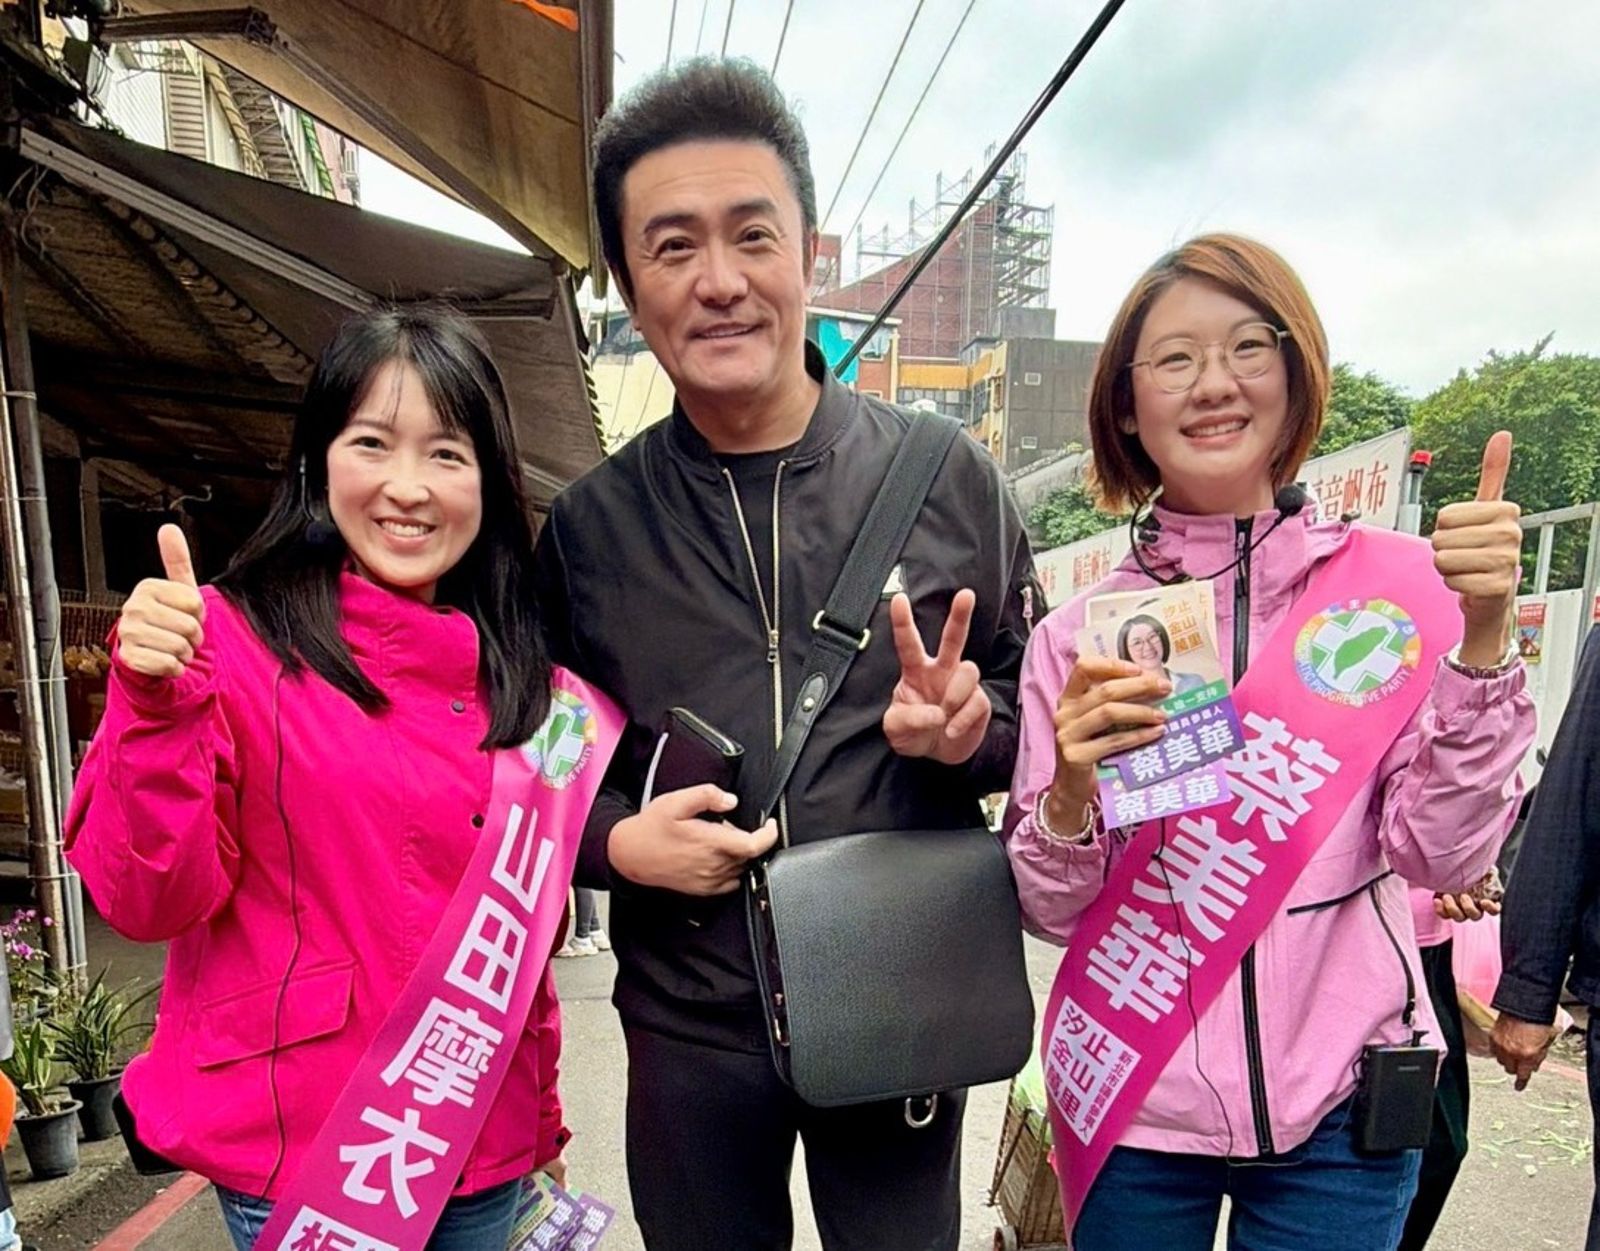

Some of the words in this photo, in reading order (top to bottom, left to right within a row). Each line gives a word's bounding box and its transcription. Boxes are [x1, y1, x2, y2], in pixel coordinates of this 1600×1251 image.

[1168, 616, 1197, 635] 金山
[1311, 679, 1381, 709] PROGRESSIVE
[1380, 667, 1412, 698] PARTY
[1128, 719, 1235, 783] 蔡美華
[1113, 774, 1220, 822] 蔡美華
[1085, 711, 1342, 1024] 蔡美華
[339, 803, 556, 1220] 山田摩衣
[1061, 1005, 1112, 1067] 汐止
[1047, 1064, 1081, 1124] 萬里
[1052, 1037, 1096, 1095] 金山
